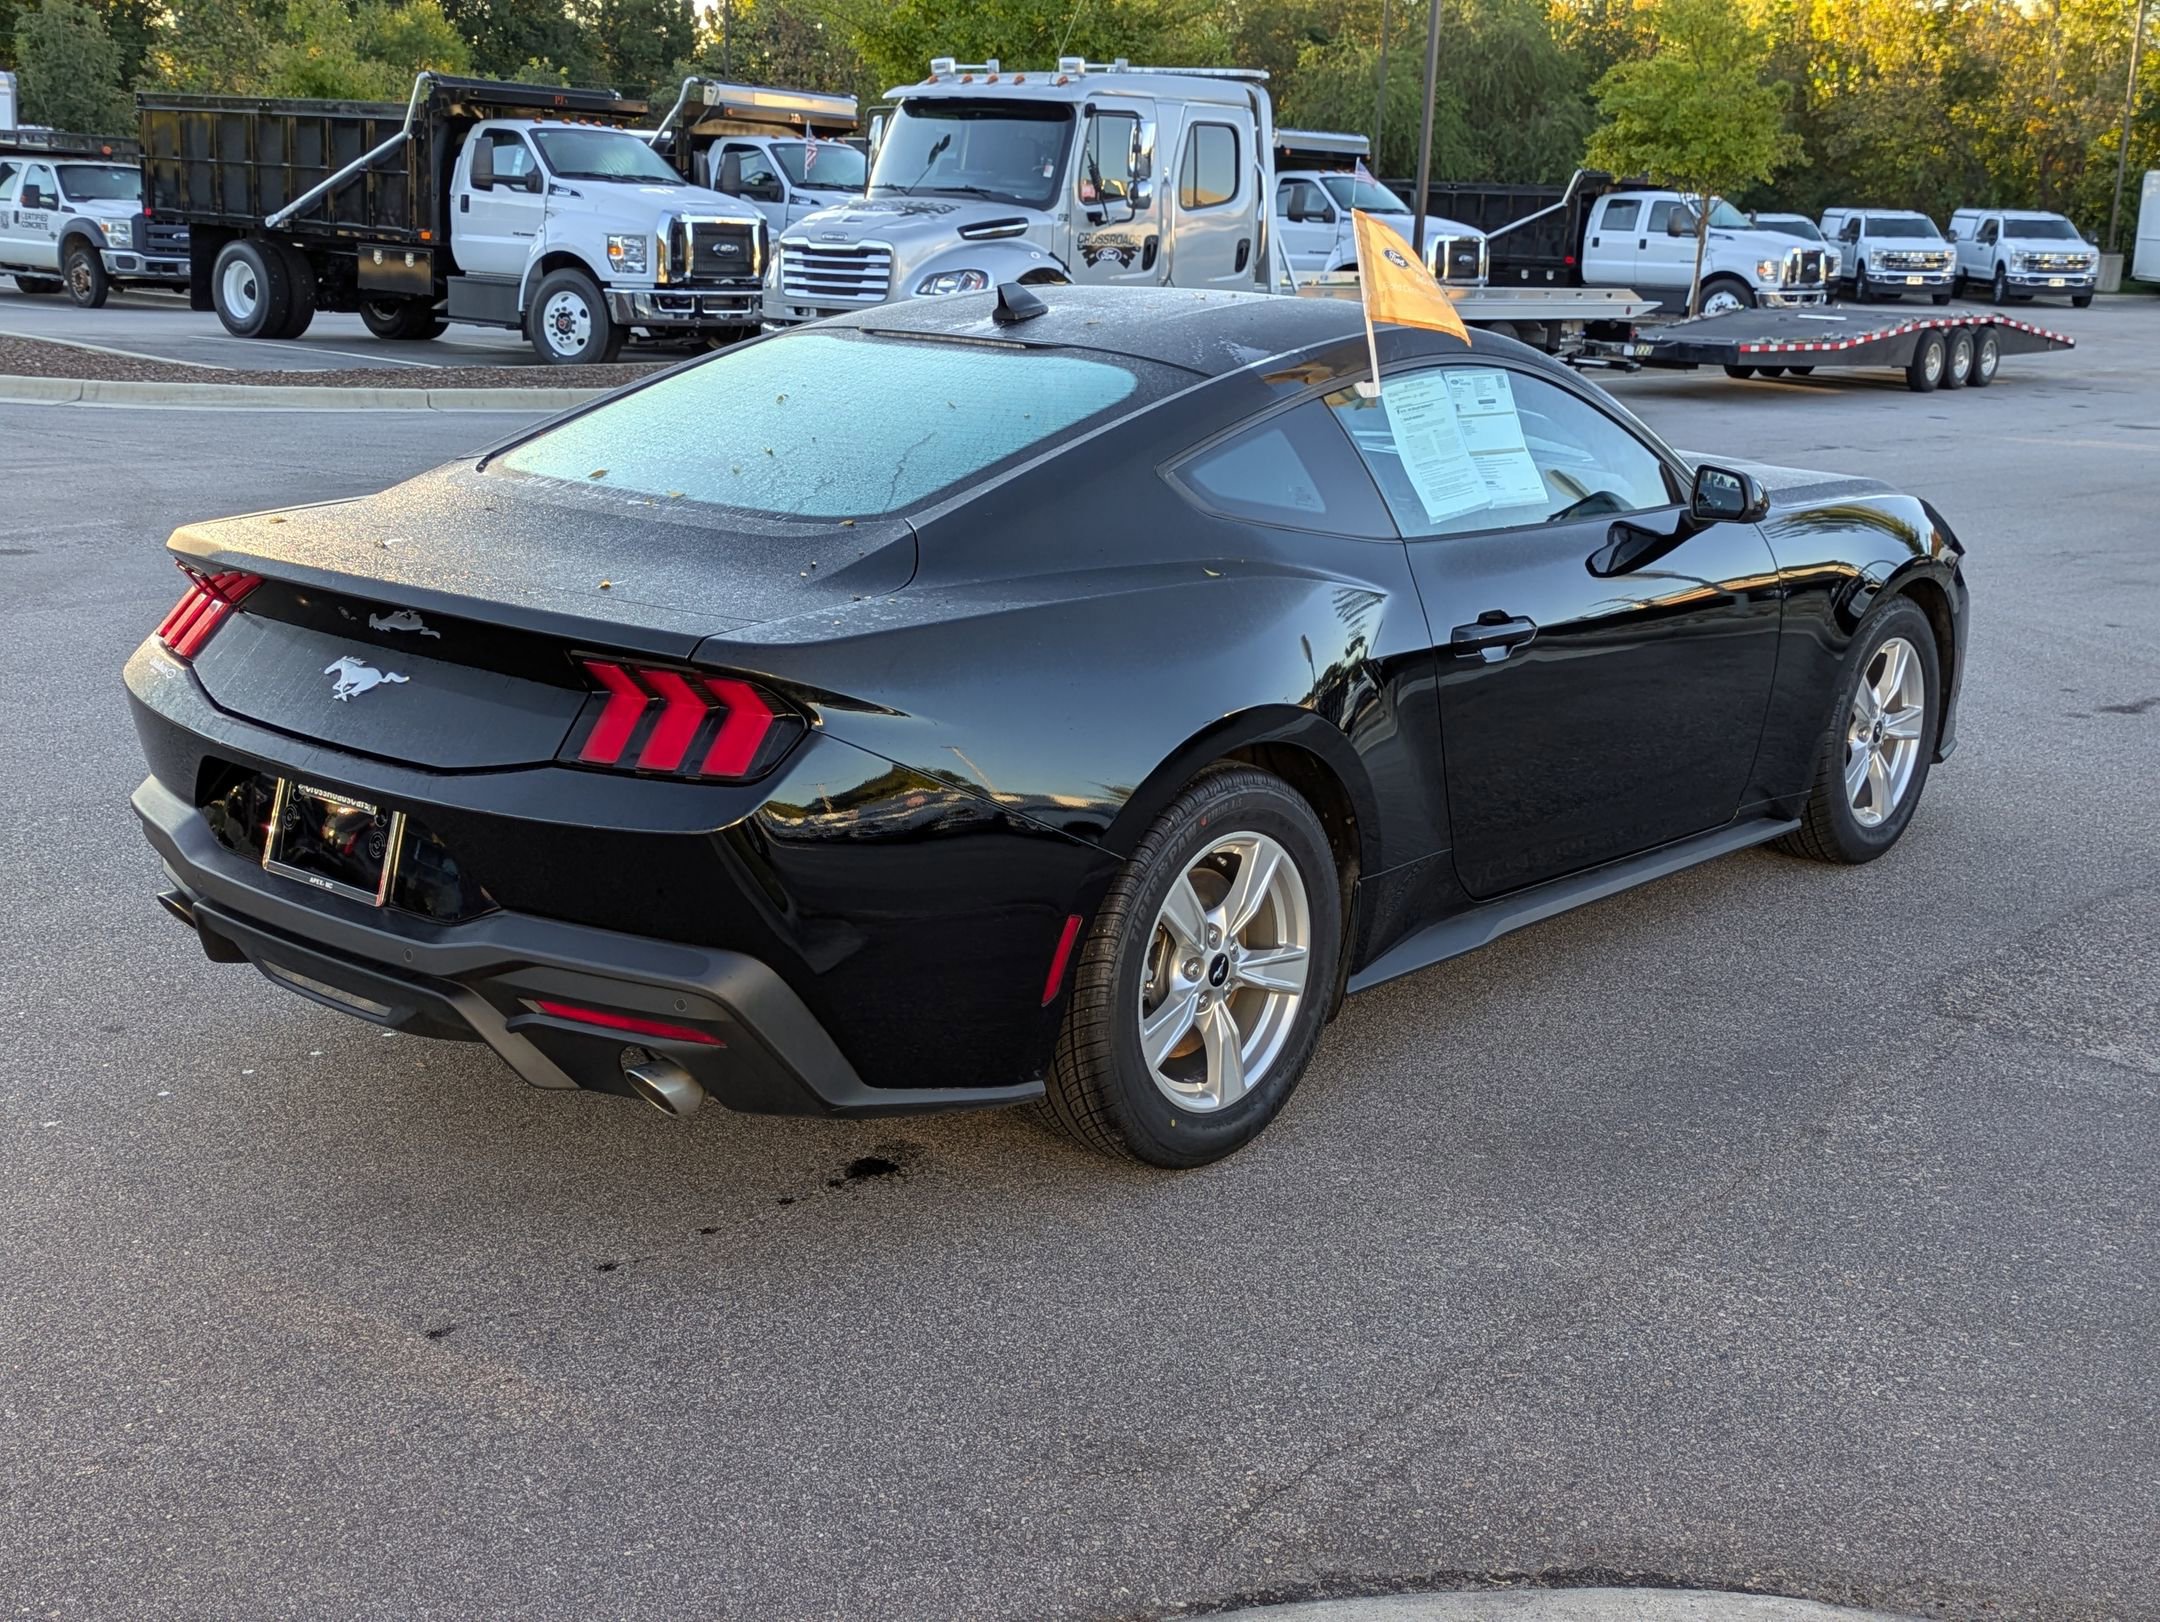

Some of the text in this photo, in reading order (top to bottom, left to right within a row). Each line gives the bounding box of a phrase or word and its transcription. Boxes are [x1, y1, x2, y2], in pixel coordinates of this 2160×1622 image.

[1077, 232, 1141, 246] CROSSROADS
[1129, 823, 1198, 943] TIGER PAW
